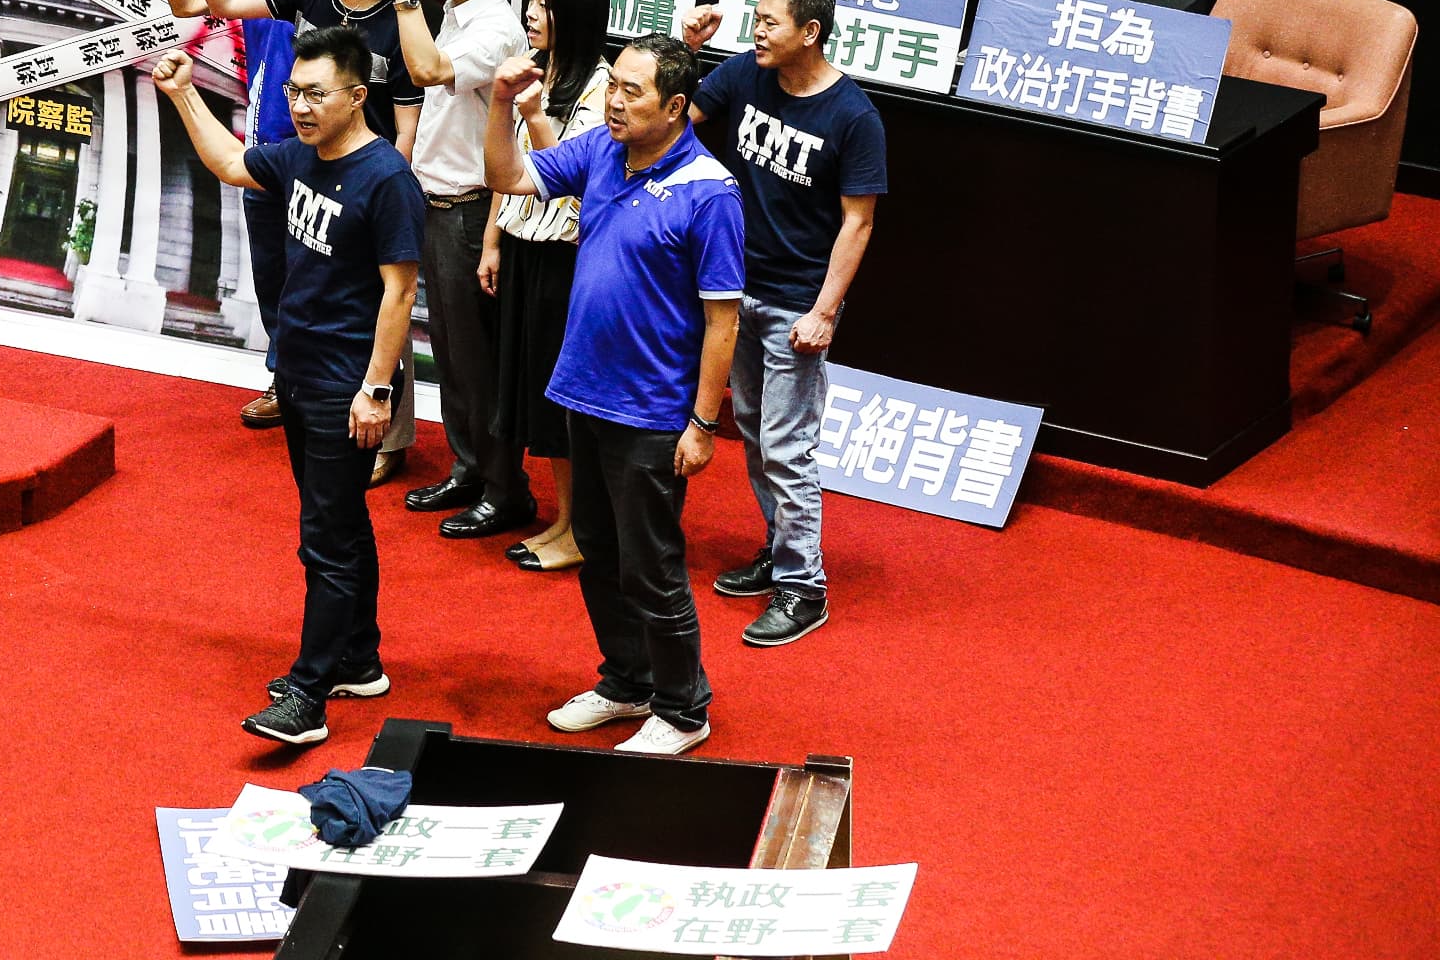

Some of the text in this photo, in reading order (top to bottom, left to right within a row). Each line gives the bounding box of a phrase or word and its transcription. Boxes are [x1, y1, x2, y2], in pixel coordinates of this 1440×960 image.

[970, 44, 1204, 139] 政治打手背書
[738, 103, 825, 175] KMT
[755, 154, 766, 168] IN
[769, 160, 812, 187] TOGETHER
[643, 178, 672, 202] KMT
[288, 178, 343, 244] KMT
[686, 880, 903, 909] 執政一套
[671, 917, 888, 946] 在野一套
